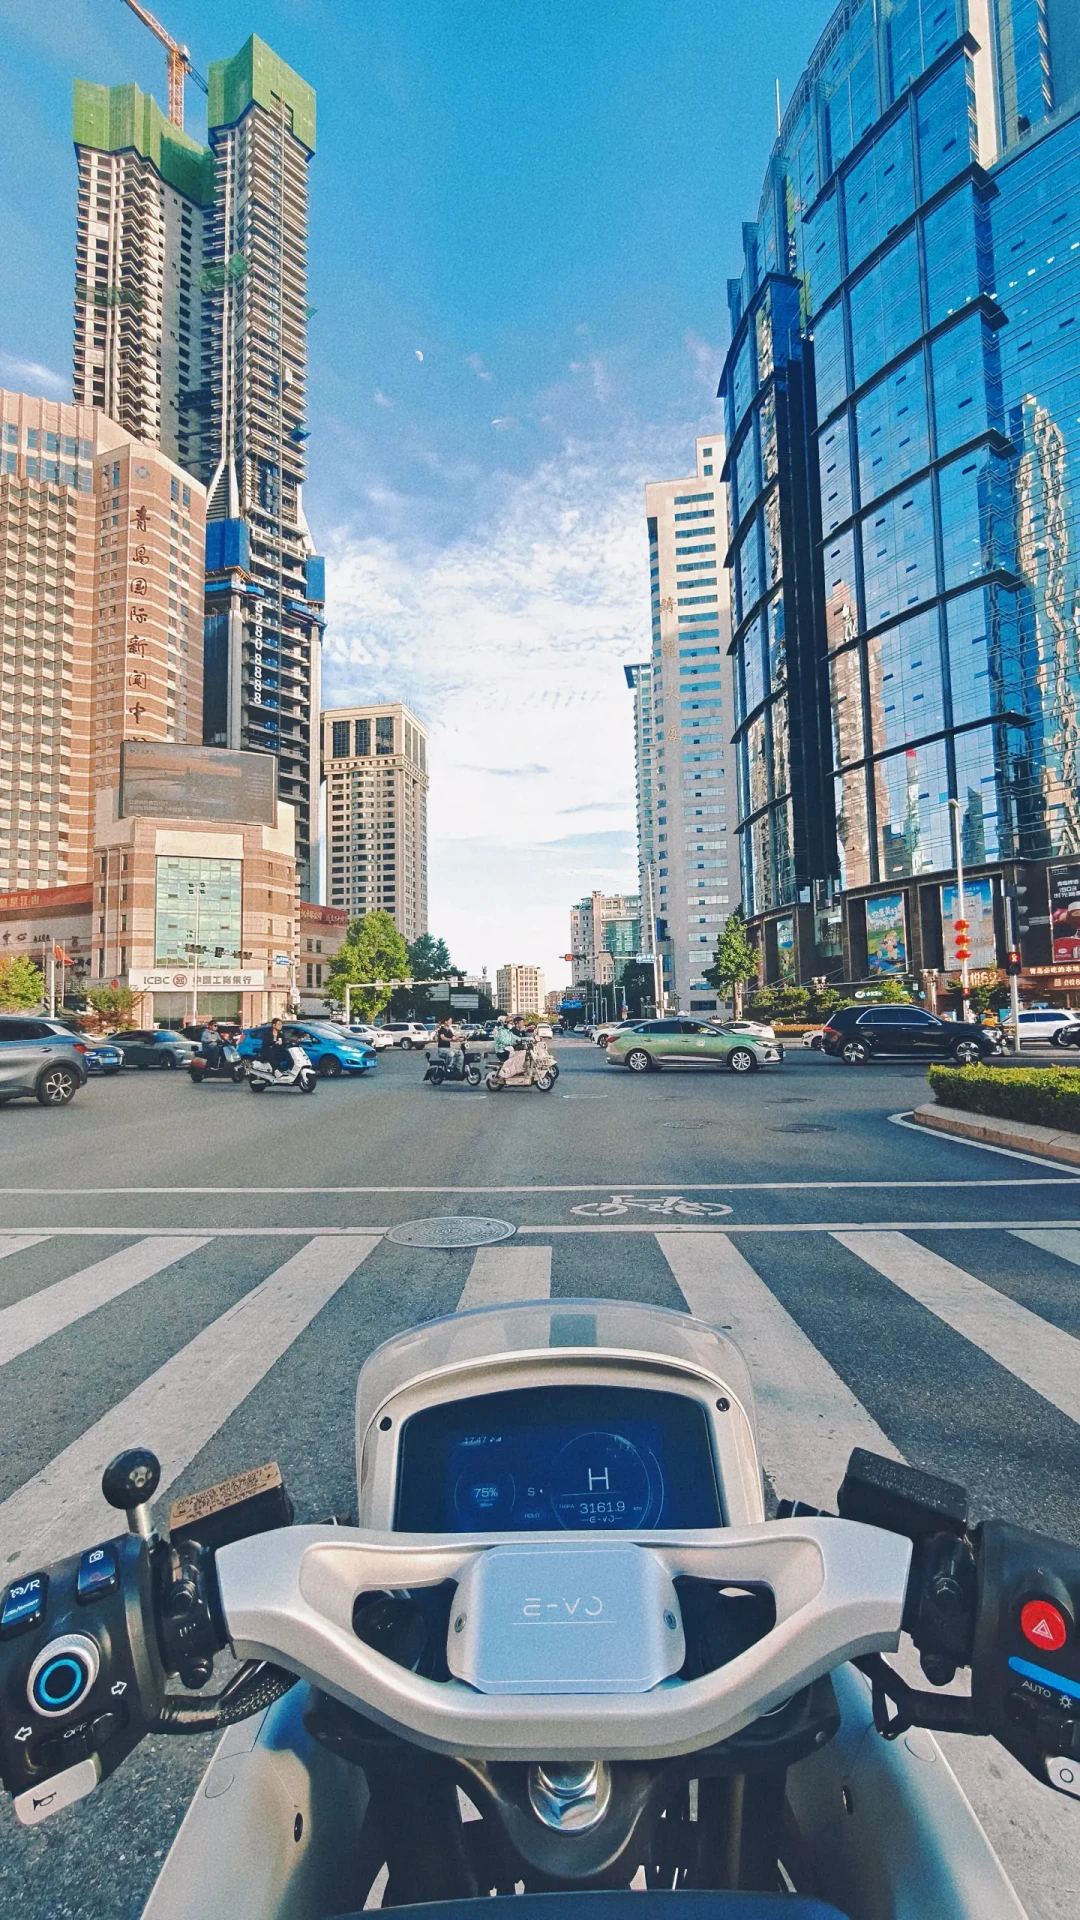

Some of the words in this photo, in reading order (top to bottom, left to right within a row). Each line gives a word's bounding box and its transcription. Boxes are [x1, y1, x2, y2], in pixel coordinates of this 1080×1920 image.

[143, 976, 170, 985] ICBC
[192, 975, 252, 985] 中国工商银行
[588, 1467, 610, 1491] H
[474, 1487, 499, 1498] 75%
[527, 1487, 536, 1497] S
[579, 1500, 626, 1514] 3161.9
[1021, 1680, 1052, 1699] AUTO
[63, 1722, 88, 1738] OFF
